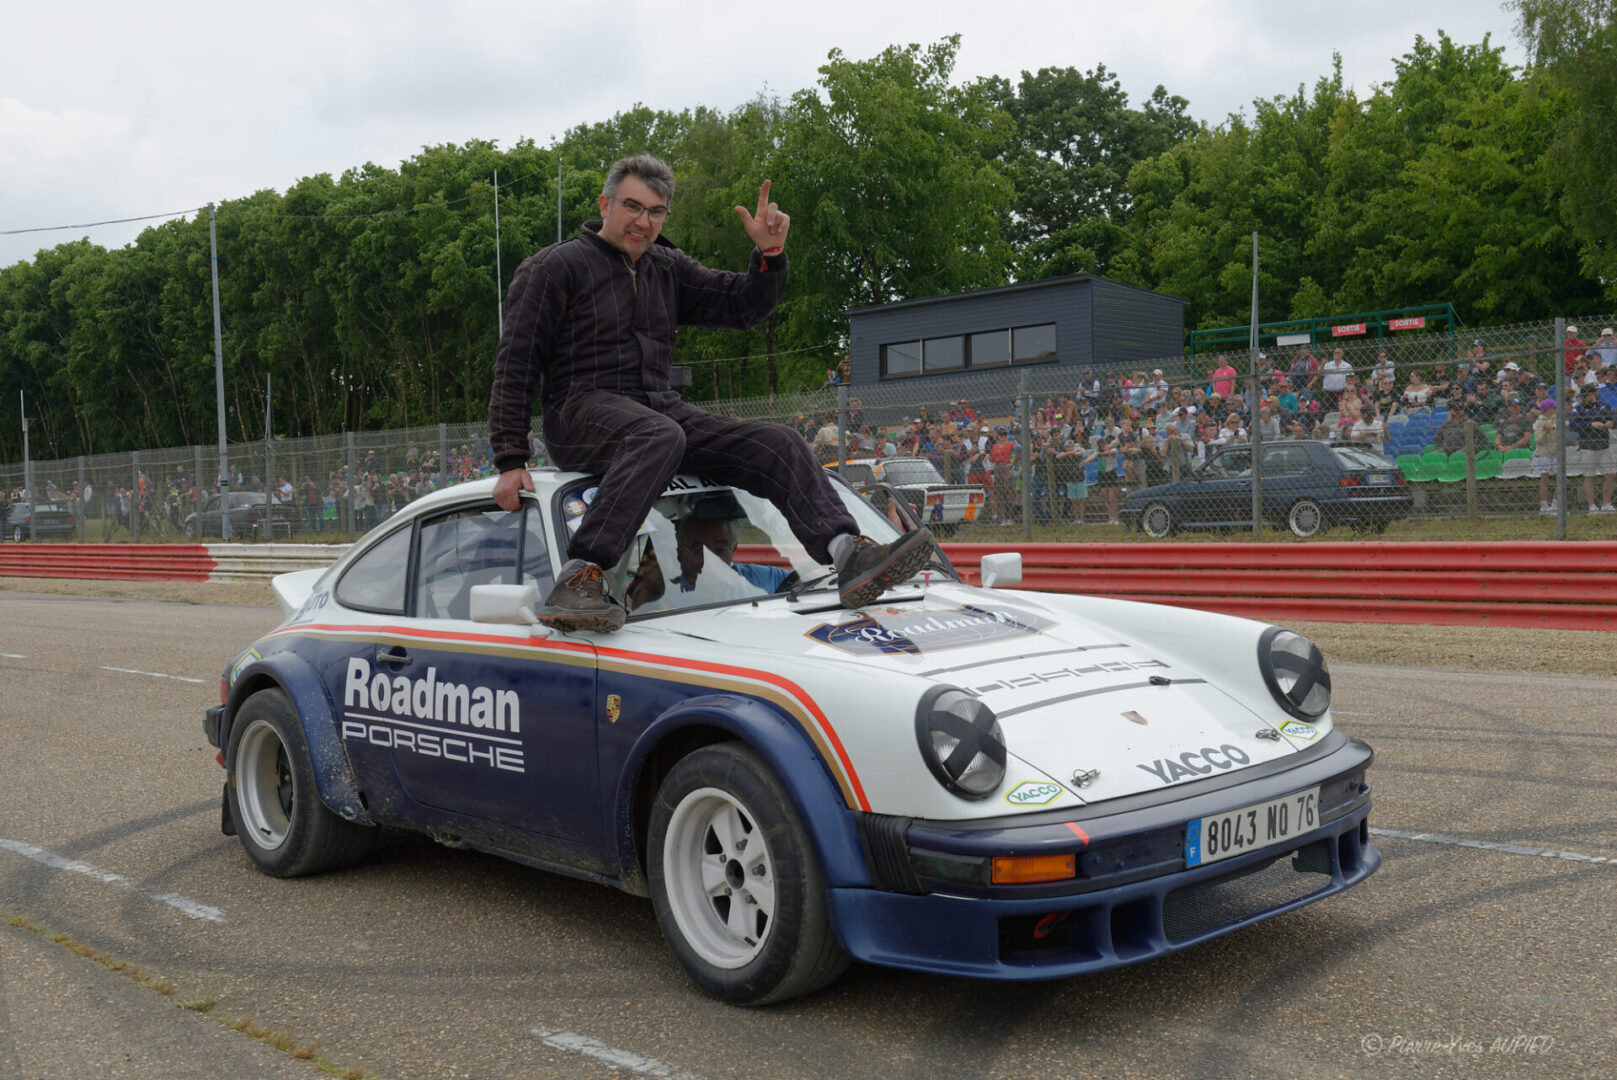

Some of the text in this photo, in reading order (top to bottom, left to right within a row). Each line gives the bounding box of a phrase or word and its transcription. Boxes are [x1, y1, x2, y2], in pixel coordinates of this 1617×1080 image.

[1337, 324, 1360, 333] SORTIE
[1394, 319, 1419, 327] SORTIE
[845, 610, 1018, 643] Roadman
[344, 657, 520, 733] Roadman
[342, 721, 525, 773] PORSCHE
[1136, 744, 1251, 784] YACCO
[1011, 785, 1058, 801] YACCO
[1207, 810, 1257, 856] 8043
[1297, 793, 1314, 831] 76
[1190, 847, 1196, 858] F
